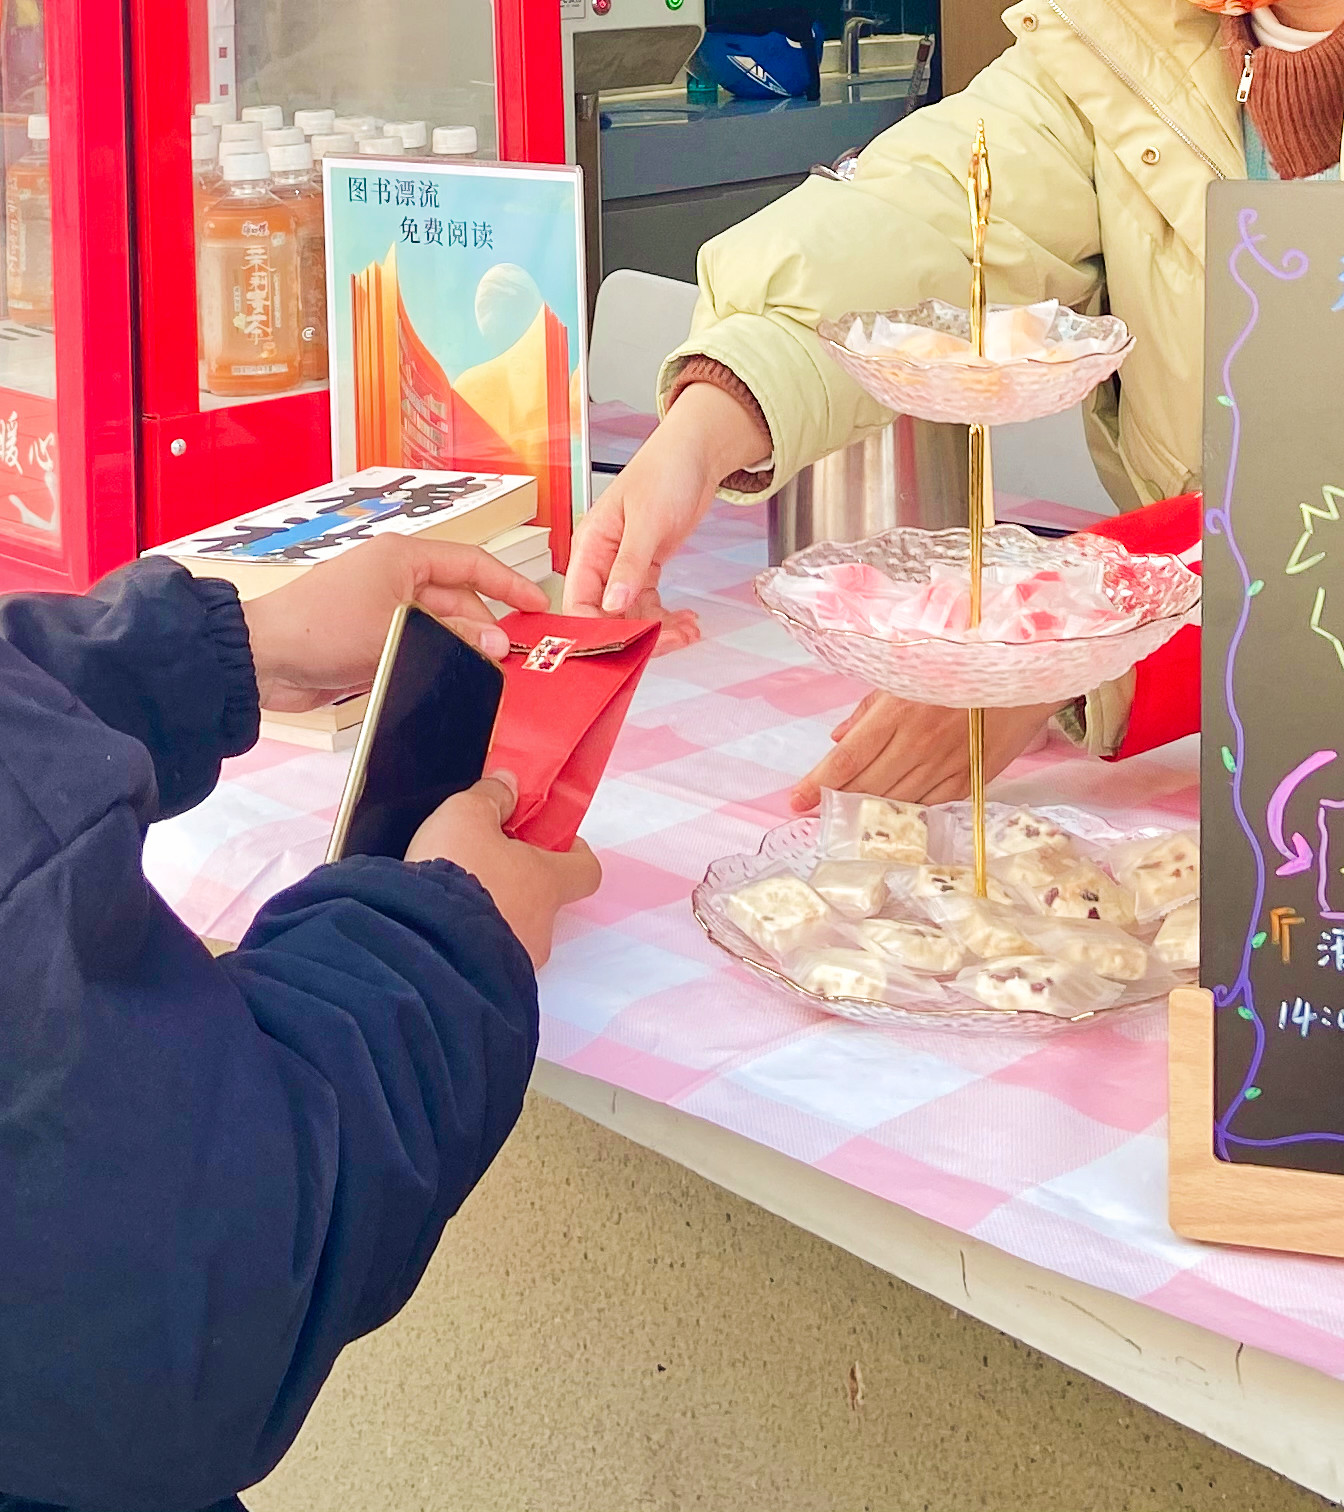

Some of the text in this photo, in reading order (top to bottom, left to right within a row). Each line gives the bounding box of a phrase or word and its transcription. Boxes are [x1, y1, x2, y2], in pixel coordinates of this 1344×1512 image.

[347, 175, 440, 209] 图书漂流
[399, 216, 494, 251] 免费阅读
